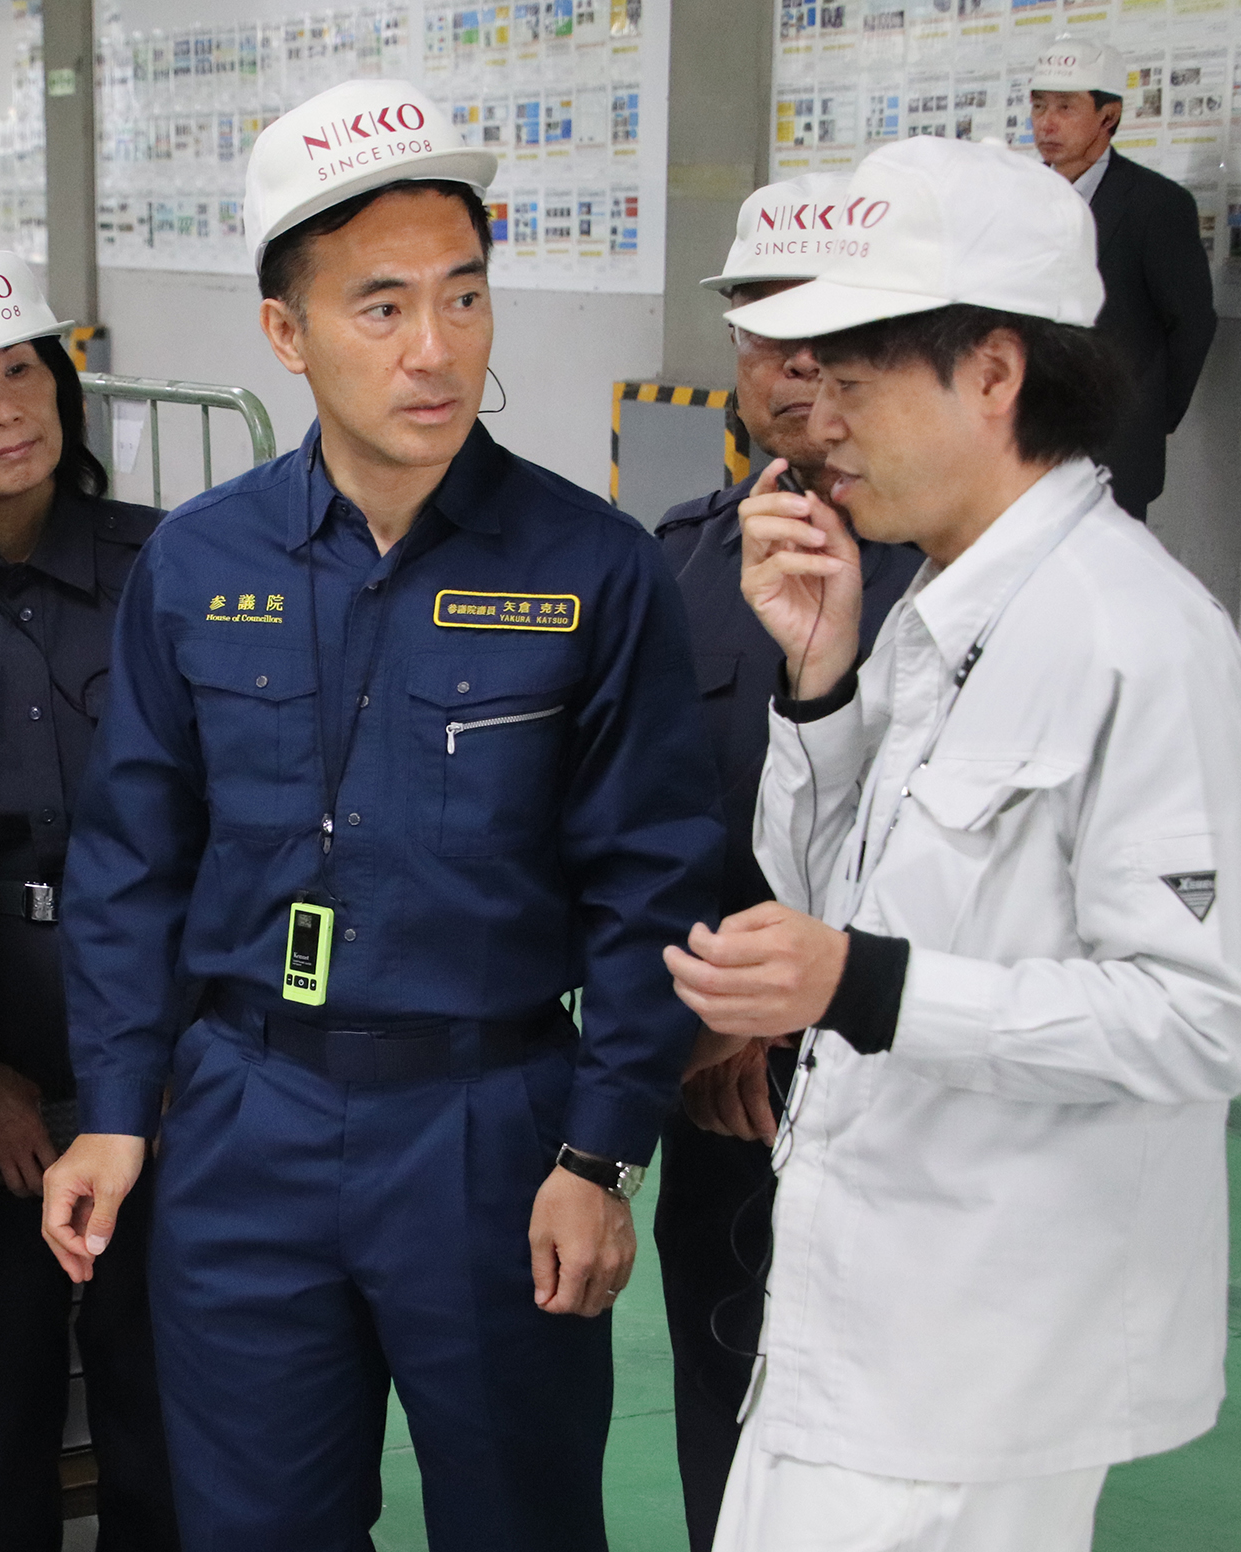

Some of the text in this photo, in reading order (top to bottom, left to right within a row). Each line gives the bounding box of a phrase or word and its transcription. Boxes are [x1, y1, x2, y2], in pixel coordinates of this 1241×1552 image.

[302, 103, 425, 161] NIKKO
[318, 139, 433, 181] SINCE 1908
[754, 240, 808, 256] SINCE
[209, 594, 284, 611] 参議院
[447, 600, 567, 616] 参議院議員 矢倉 克夫
[206, 614, 283, 624] House of Councillors
[500, 614, 569, 625] YAKURA KATSUO
